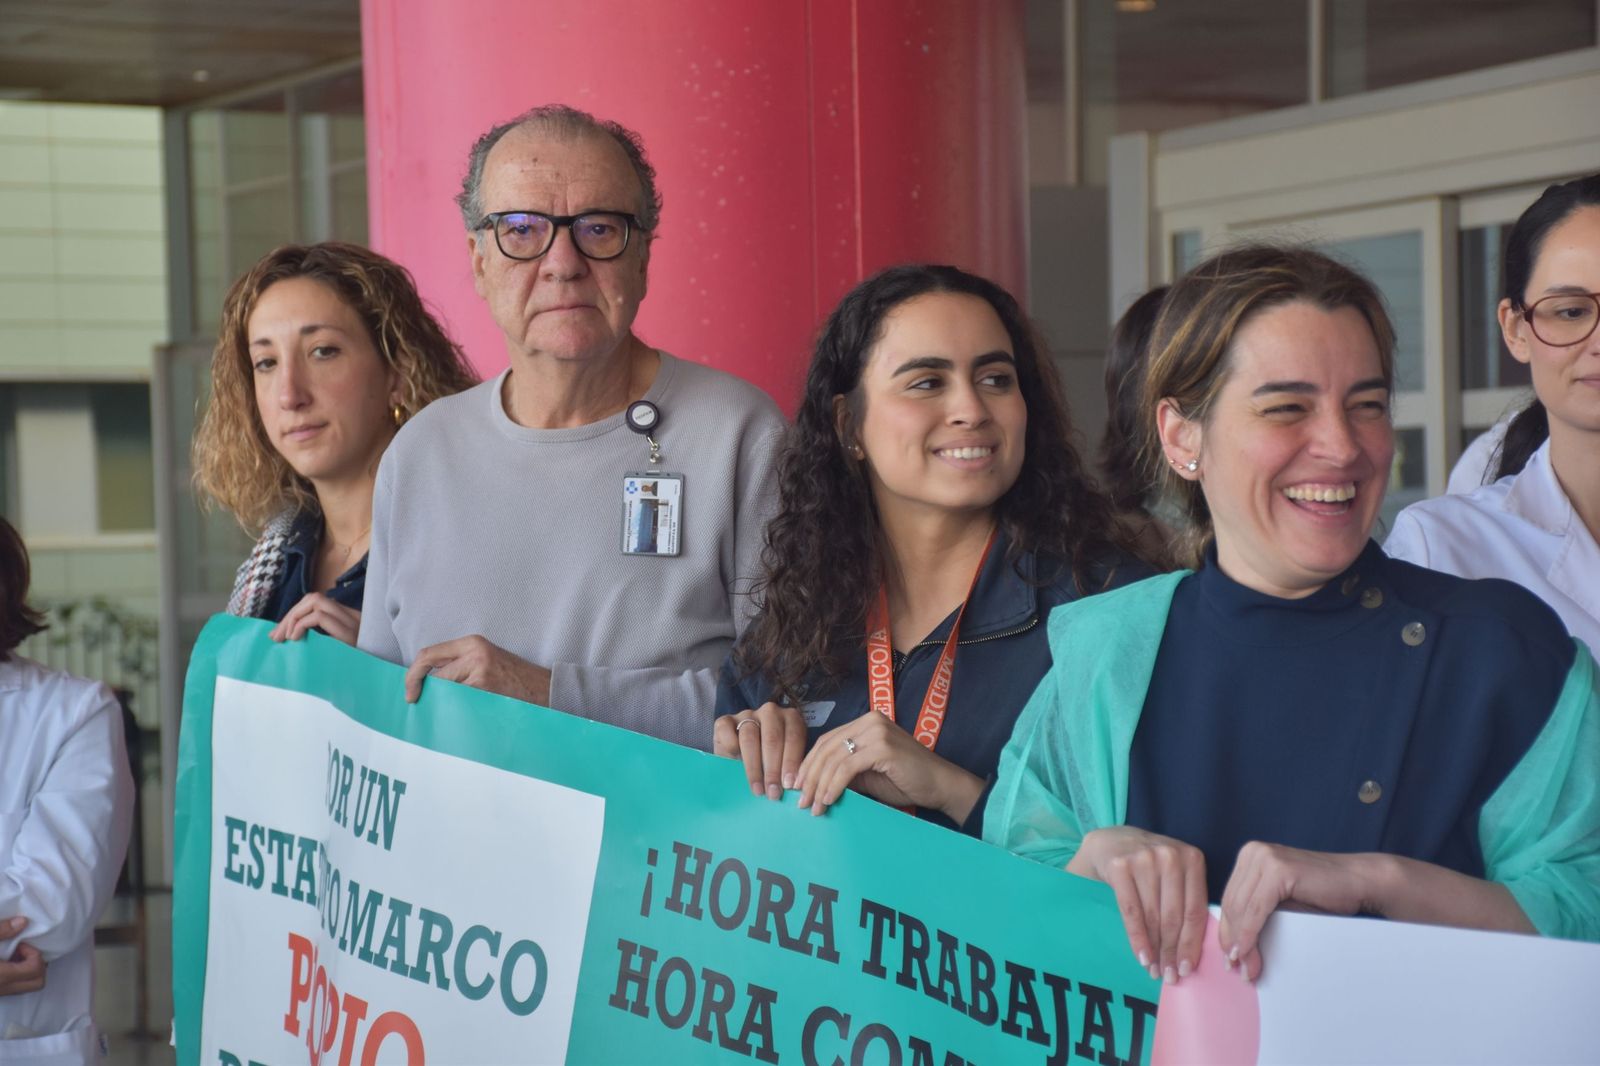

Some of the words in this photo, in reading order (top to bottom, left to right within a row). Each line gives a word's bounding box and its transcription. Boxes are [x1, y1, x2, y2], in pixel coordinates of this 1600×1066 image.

[870, 628, 893, 720] EDICO/A
[325, 741, 354, 829] OR
[353, 764, 407, 852] UN
[338, 879, 548, 1016] MARCO
[640, 841, 840, 964] ¡HORA
[608, 938, 779, 1065] HORA
